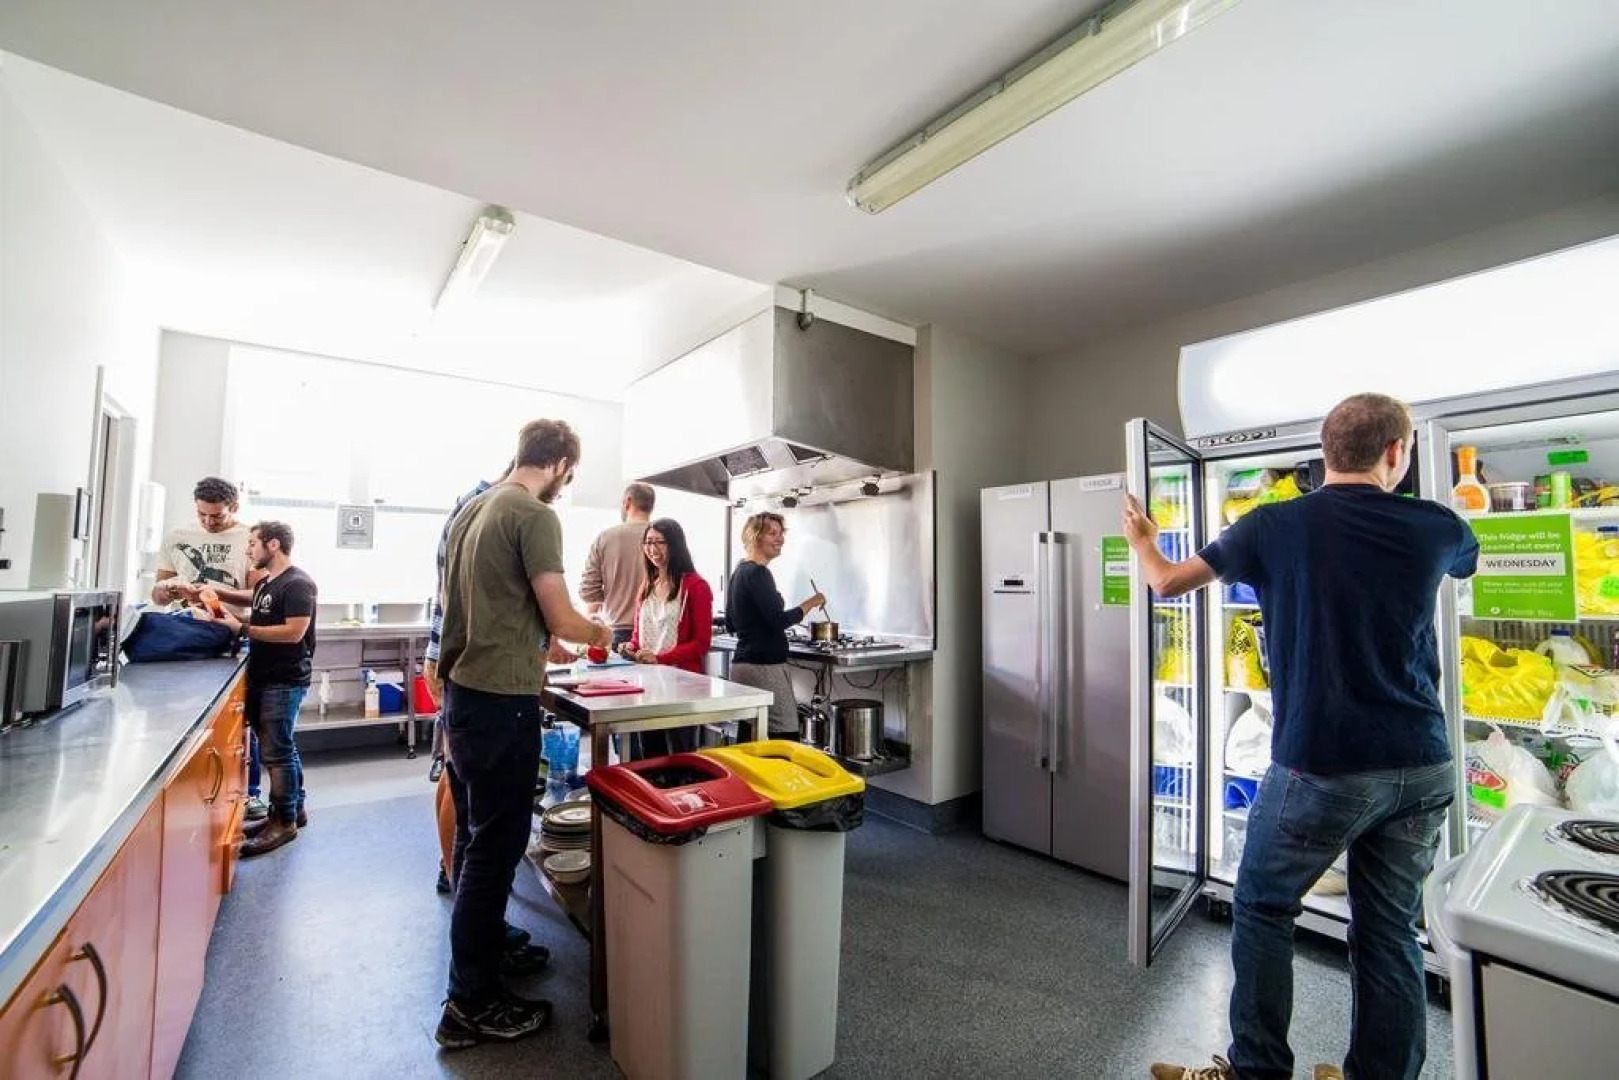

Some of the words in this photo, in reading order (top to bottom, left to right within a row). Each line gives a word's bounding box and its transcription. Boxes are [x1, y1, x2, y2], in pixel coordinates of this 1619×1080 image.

[1480, 533, 1498, 541] This
[1499, 532, 1527, 542] fridge
[1529, 531, 1546, 540] will
[1547, 531, 1560, 539] be
[1516, 543, 1533, 551] out
[1534, 543, 1561, 552] every
[1485, 559, 1557, 568] WEDNESDAY
